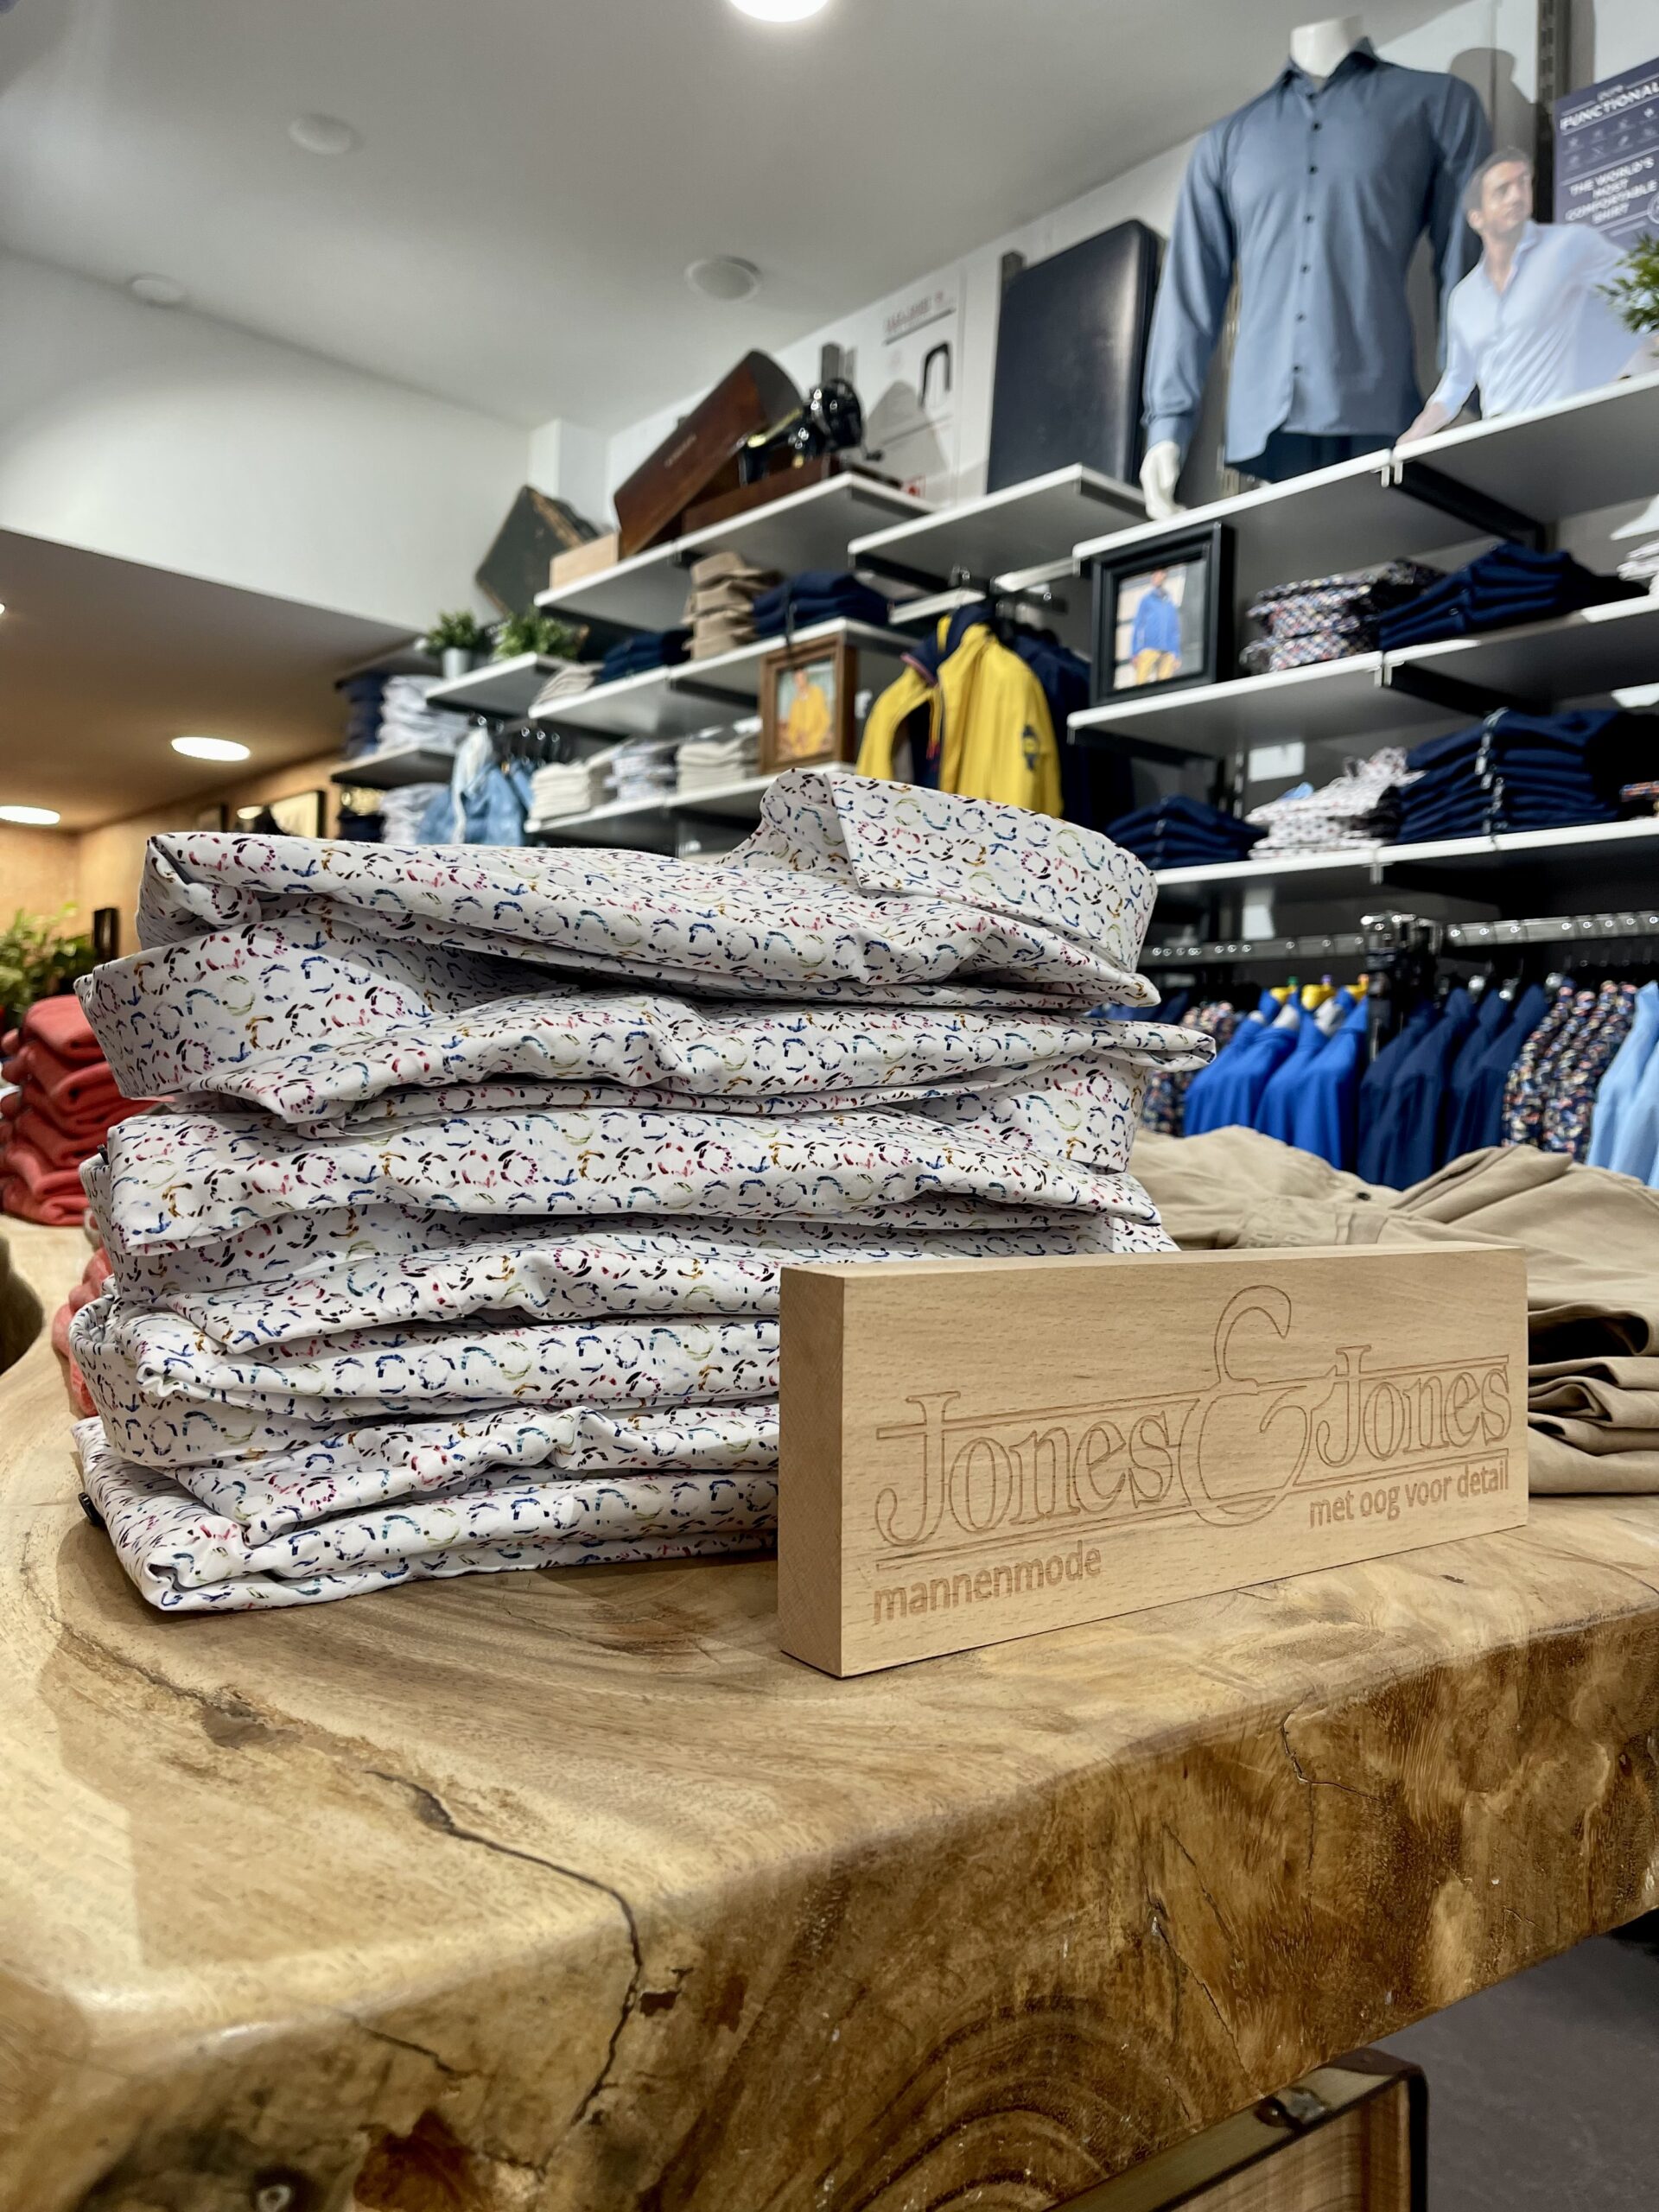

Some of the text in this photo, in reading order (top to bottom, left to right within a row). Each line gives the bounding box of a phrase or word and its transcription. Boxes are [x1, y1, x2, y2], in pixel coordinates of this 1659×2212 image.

[1559, 81, 1659, 131] FUNCTIONAL
[1565, 178, 1657, 222] COMFORTABLE
[1569, 156, 1655, 198] THE WORLD'S
[874, 1389, 1173, 1548] Jones
[1316, 1344, 1512, 1467] Jones
[1309, 1455, 1510, 1529] met oog voor detail
[873, 1539, 1103, 1625] mannenmode
